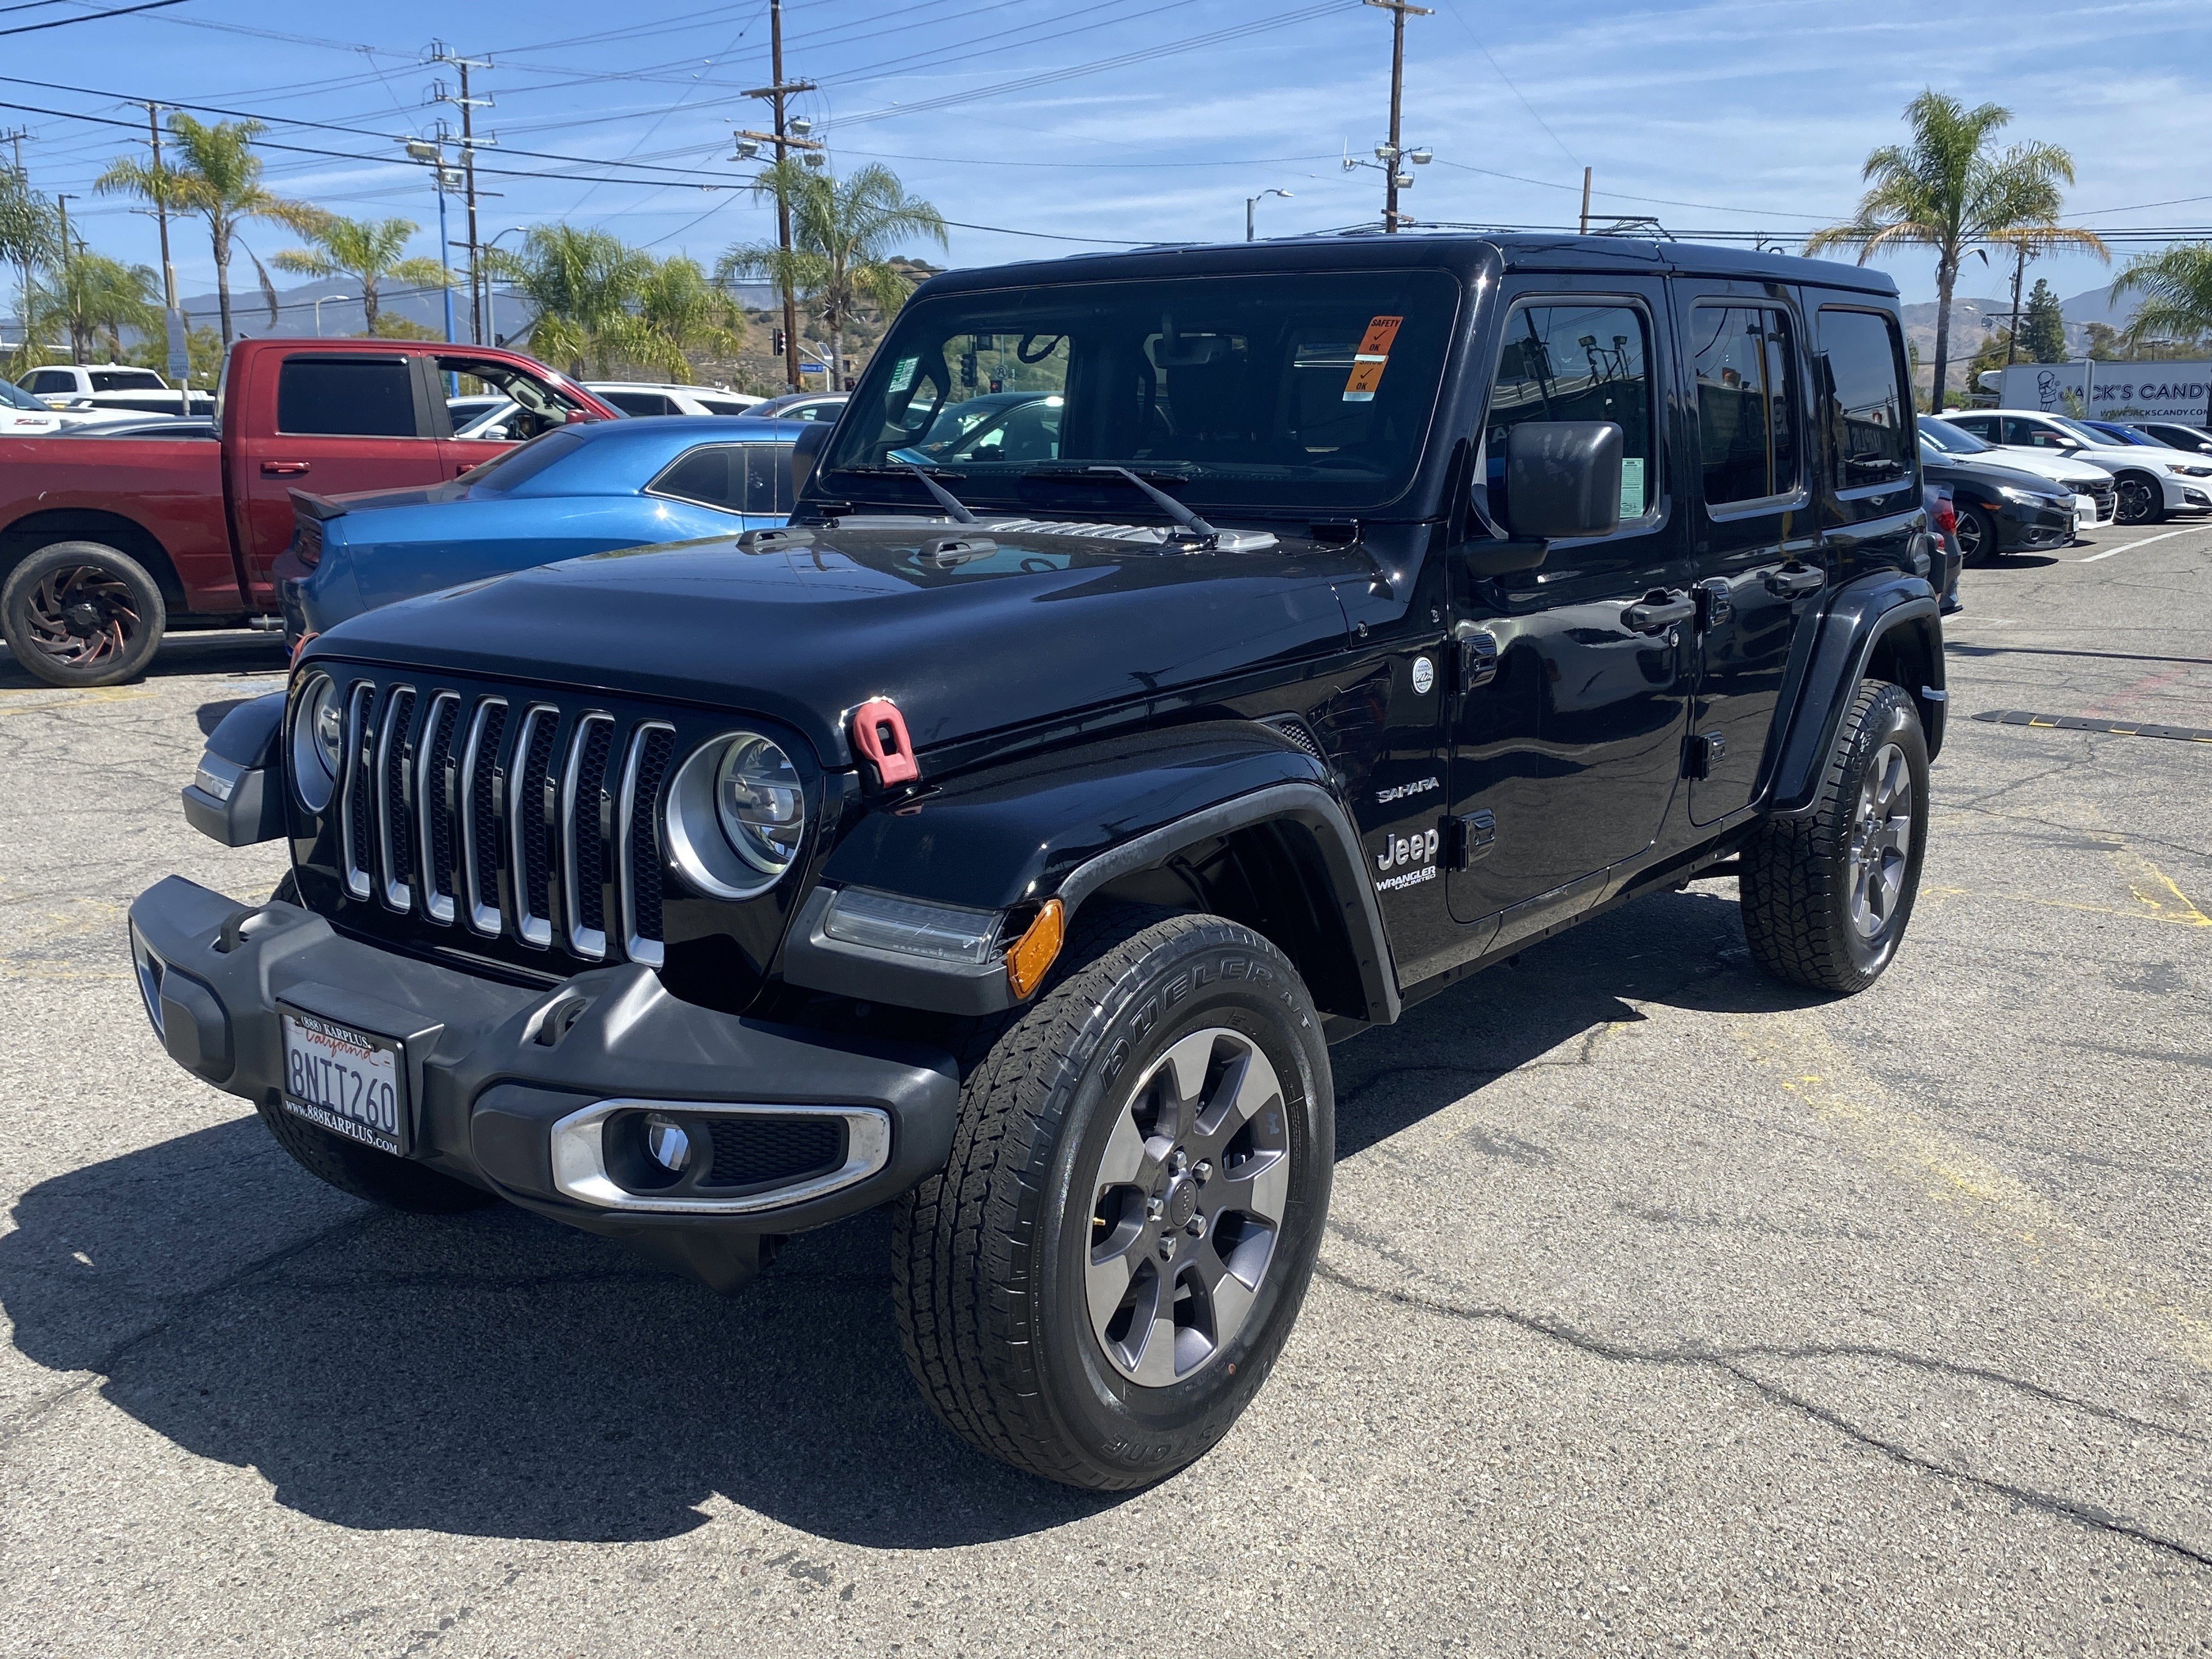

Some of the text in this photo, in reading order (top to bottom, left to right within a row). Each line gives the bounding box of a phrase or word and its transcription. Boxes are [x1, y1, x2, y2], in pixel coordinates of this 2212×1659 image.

[2058, 384, 2133, 401] JACK'S
[1375, 777, 1440, 803] SAHARA
[1377, 828, 1439, 871] Jeep
[1376, 865, 1436, 891] WRANGLER
[1395, 873, 1436, 890] UNLIMITED
[301, 1015, 368, 1048] (888) KARPLUS
[1098, 956, 1273, 1095] DUELER
[306, 1029, 379, 1066] California
[291, 1048, 395, 1132] 8NIT260
